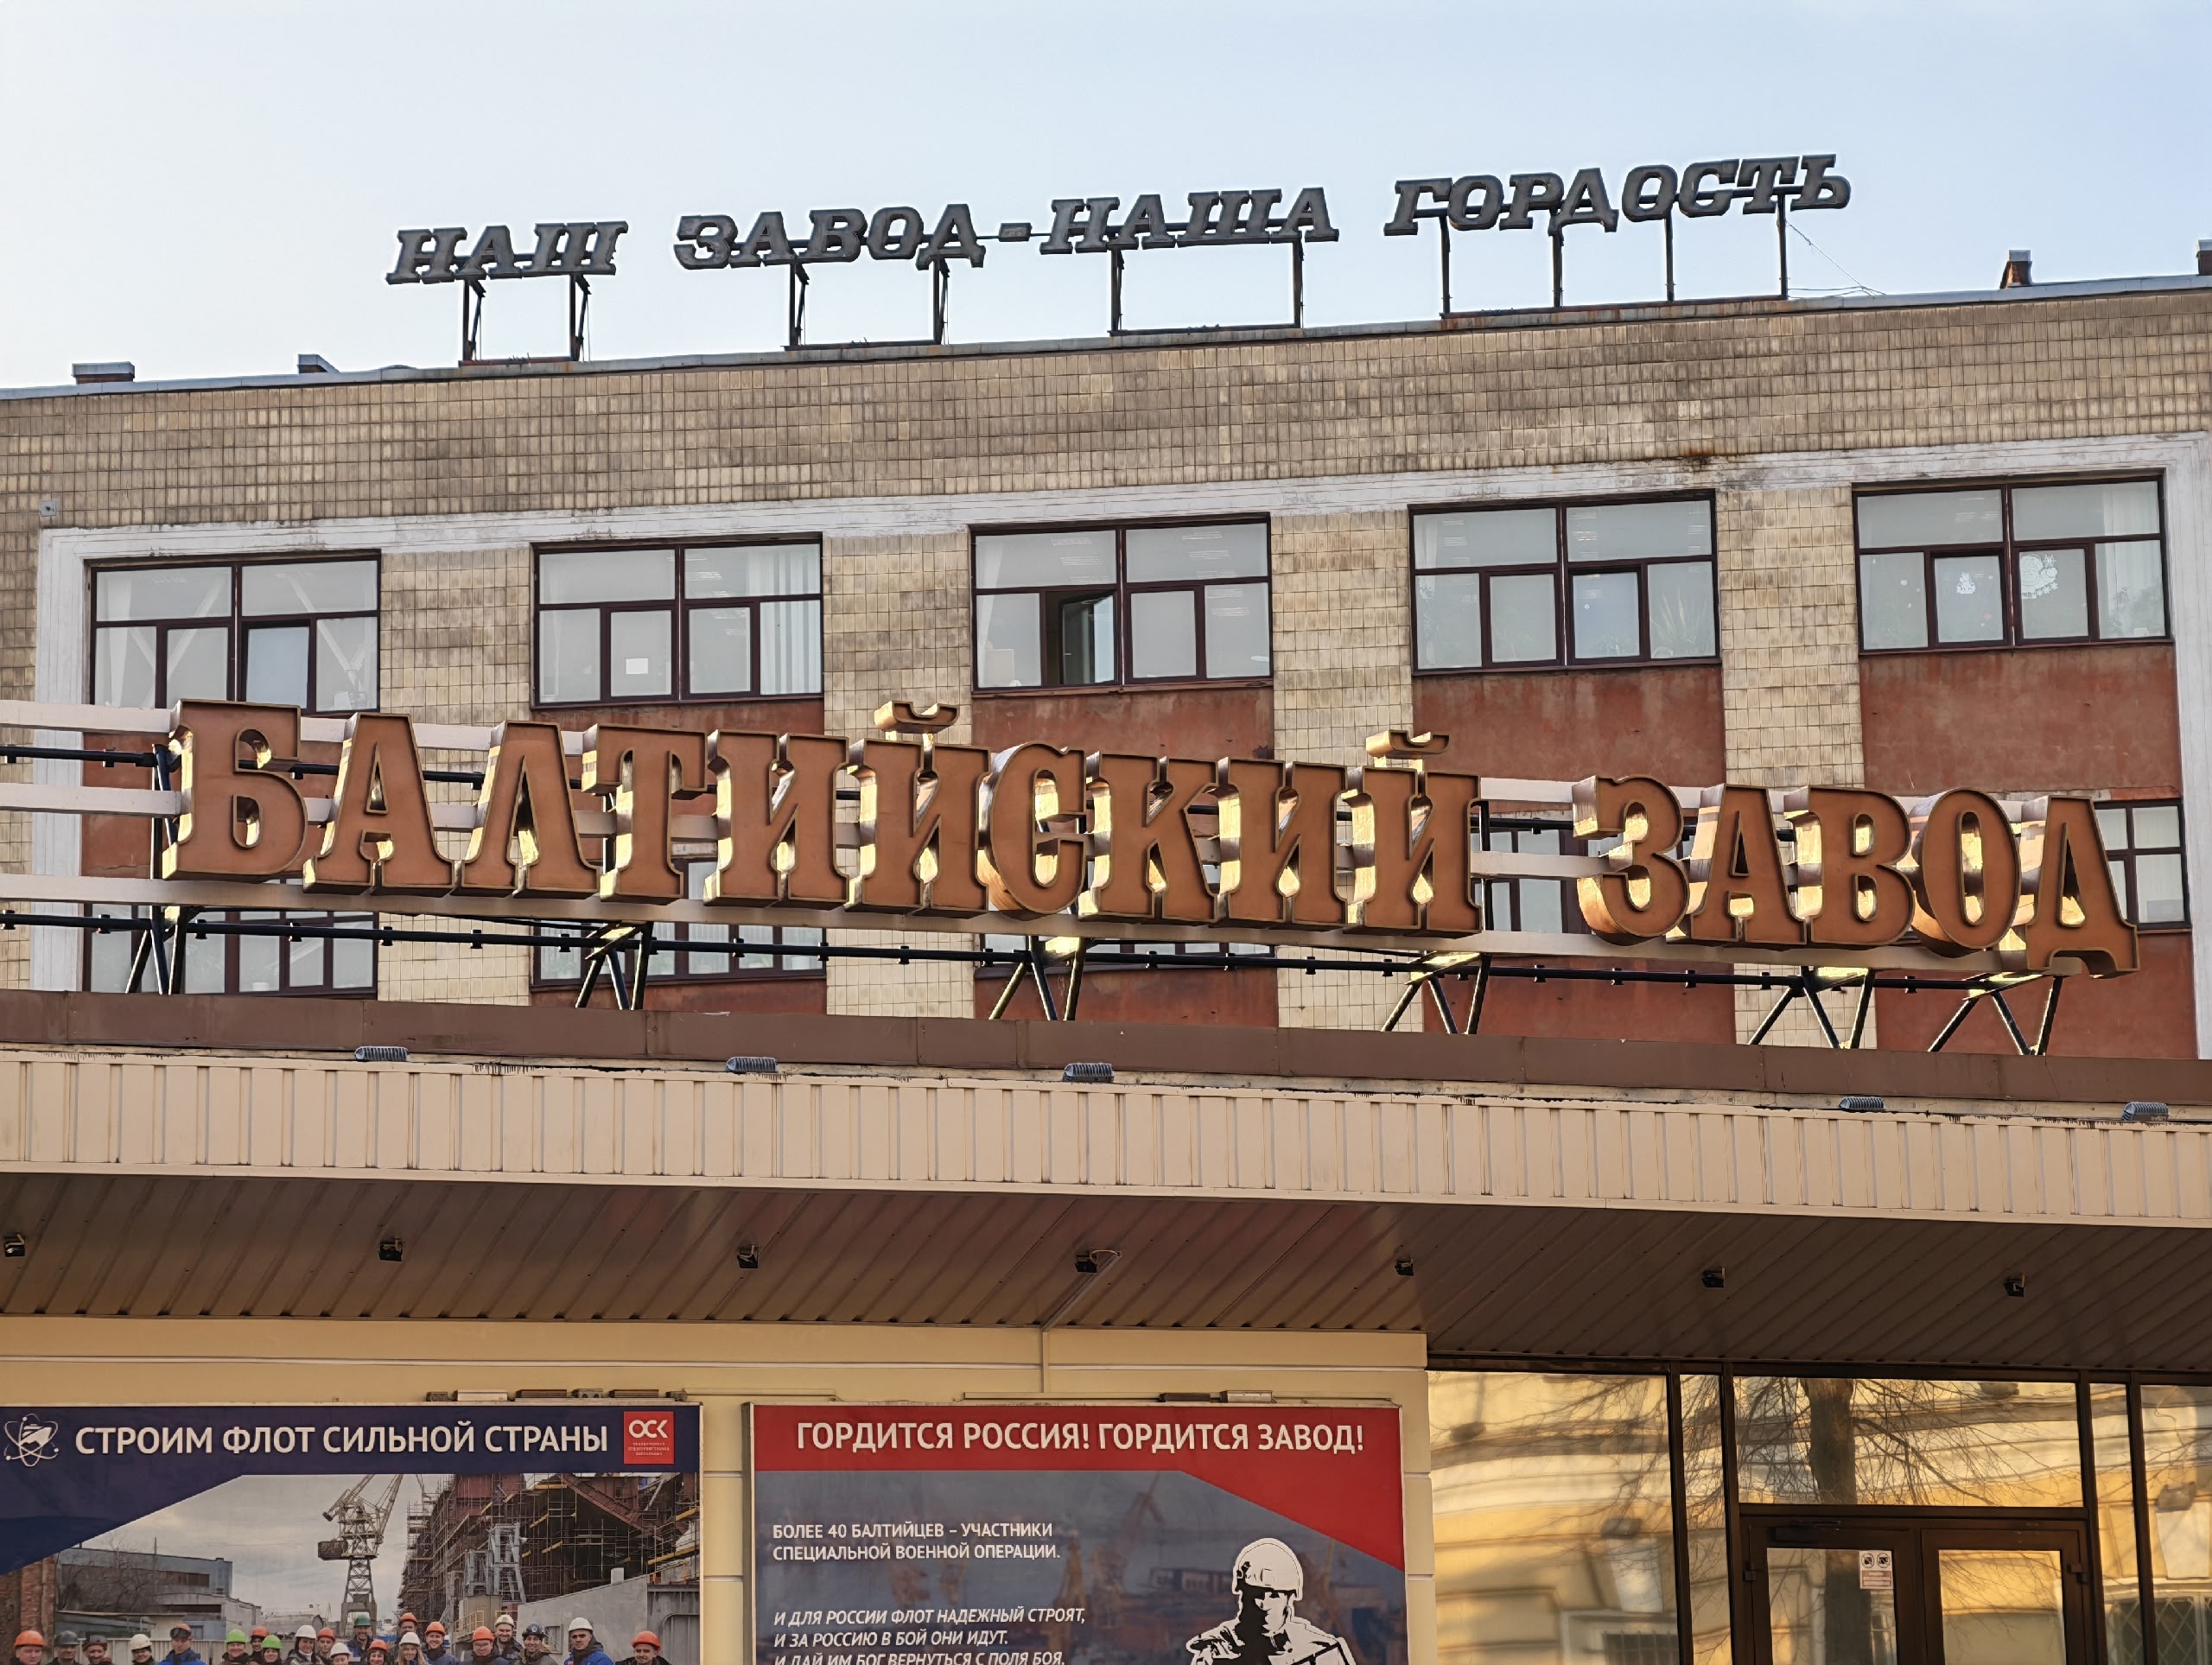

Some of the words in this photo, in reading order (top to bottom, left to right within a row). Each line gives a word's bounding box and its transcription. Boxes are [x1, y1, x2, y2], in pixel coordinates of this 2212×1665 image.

[385, 220, 629, 286] НАШ
[1383, 153, 1852, 238] ГОРДОСТЬ
[162, 698, 1484, 938] БАЛТИЙСКИЙ
[1573, 774, 2139, 978] ЗАВОД
[75, 1427, 213, 1454] СТРОИМ
[222, 1426, 315, 1454] ФЛОТ
[323, 1420, 474, 1453] СИЛЬНОЙ
[485, 1425, 607, 1452] СТРАНЫ
[628, 1419, 669, 1439] ОСК
[798, 1422, 953, 1453] ГОРДИТСЯ
[963, 1422, 1090, 1450] РОССИЯ!
[1098, 1423, 1249, 1454] ГОРДИТСЯ
[1257, 1423, 1363, 1455] ЗАВОД!
[772, 1524, 823, 1539] БОЛЕЕ
[828, 1523, 847, 1539] 40
[851, 1520, 944, 1540] БАЛТИЙЦЕВ
[960, 1522, 1052, 1538] УЧАСТНИКИ
[772, 1542, 891, 1561] СПЕЦИАЛЬНОЙ
[895, 1541, 970, 1560] ВОЕННОЙ
[974, 1544, 1061, 1560] ОПЕРАЦИИ.
[773, 1611, 786, 1626] И
[787, 1611, 823, 1628] ДЛЯ
[825, 1610, 887, 1625] РОССИИ
[891, 1609, 935, 1624] ФЛОТ
[937, 1605, 1025, 1625] НАДЕЖНЫЙ
[1027, 1607, 1085, 1624] СТРОЯТ,
[773, 1633, 786, 1648] И
[789, 1633, 809, 1648] ЗА
[812, 1631, 878, 1648] РОССИЮ
[880, 1631, 892, 1646] В
[895, 1628, 927, 1646] БОЙ
[931, 1630, 963, 1646] ОНИ
[966, 1630, 1008, 1647] ИДУТ.
[774, 1655, 786, 1665] И
[790, 1652, 823, 1665] ДАЙ
[827, 1654, 853, 1665] ИМ
[855, 1653, 887, 1665] БОГ
[887, 1652, 972, 1665] ВЕРНУТЬСЯ
[975, 1652, 986, 1665] С
[988, 1651, 1029, 1665] ПОЛЯ
[1032, 1651, 1065, 1665] БОЯ.
